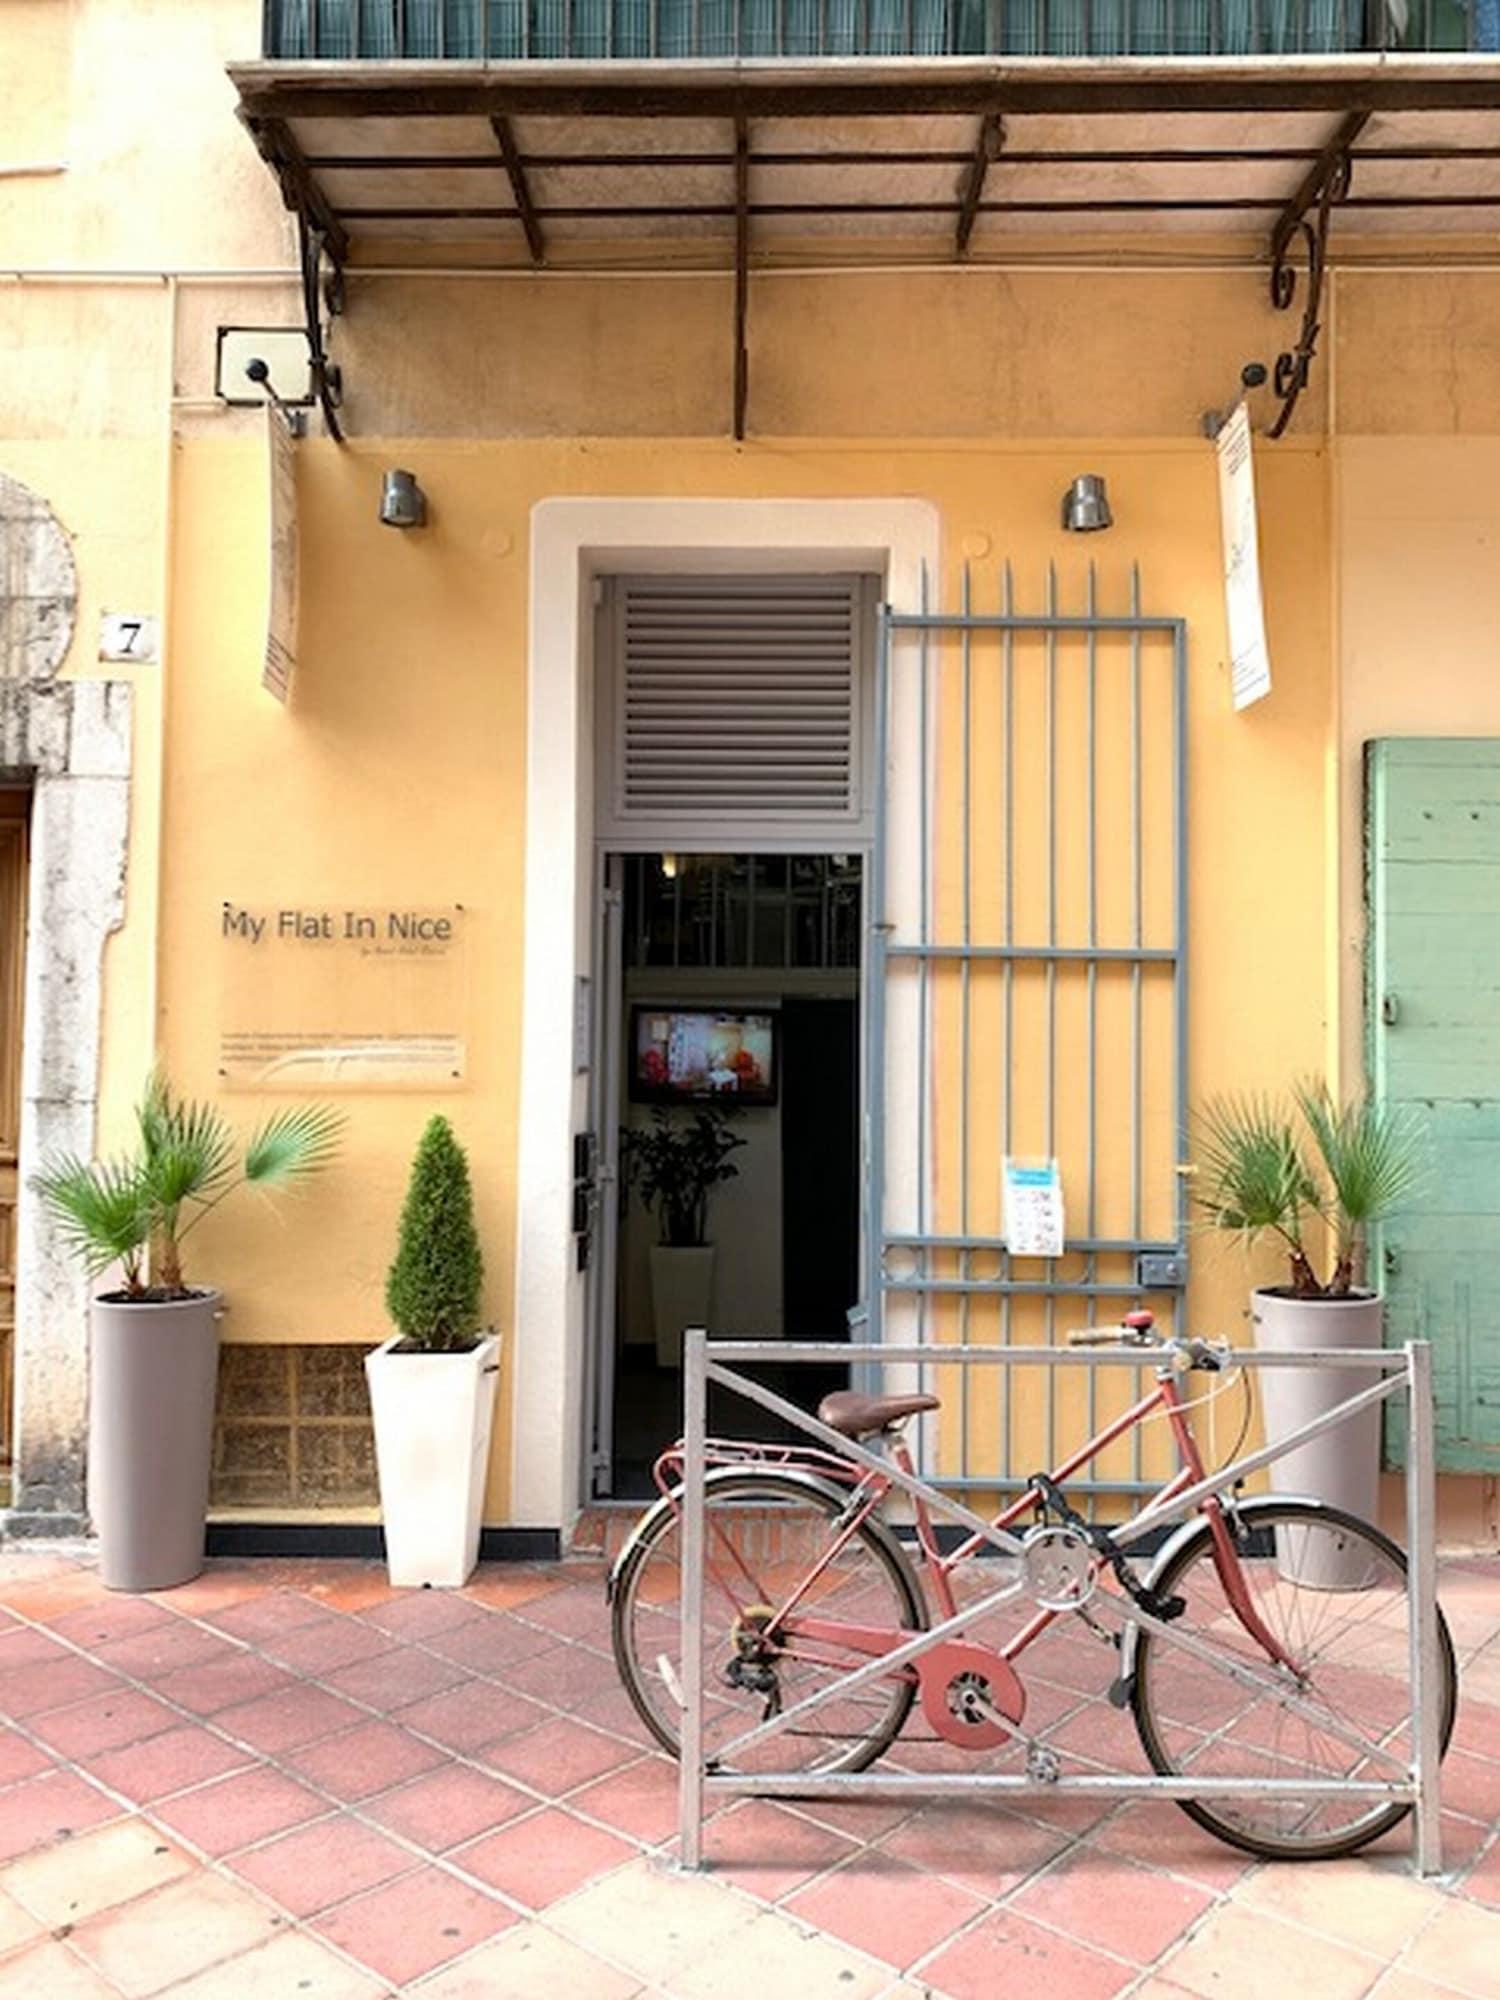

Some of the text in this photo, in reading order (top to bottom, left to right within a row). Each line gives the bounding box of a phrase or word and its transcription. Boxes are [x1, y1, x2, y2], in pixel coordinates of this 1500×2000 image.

[118, 623, 141, 654] 7
[222, 911, 452, 944] My Flat In Nice
